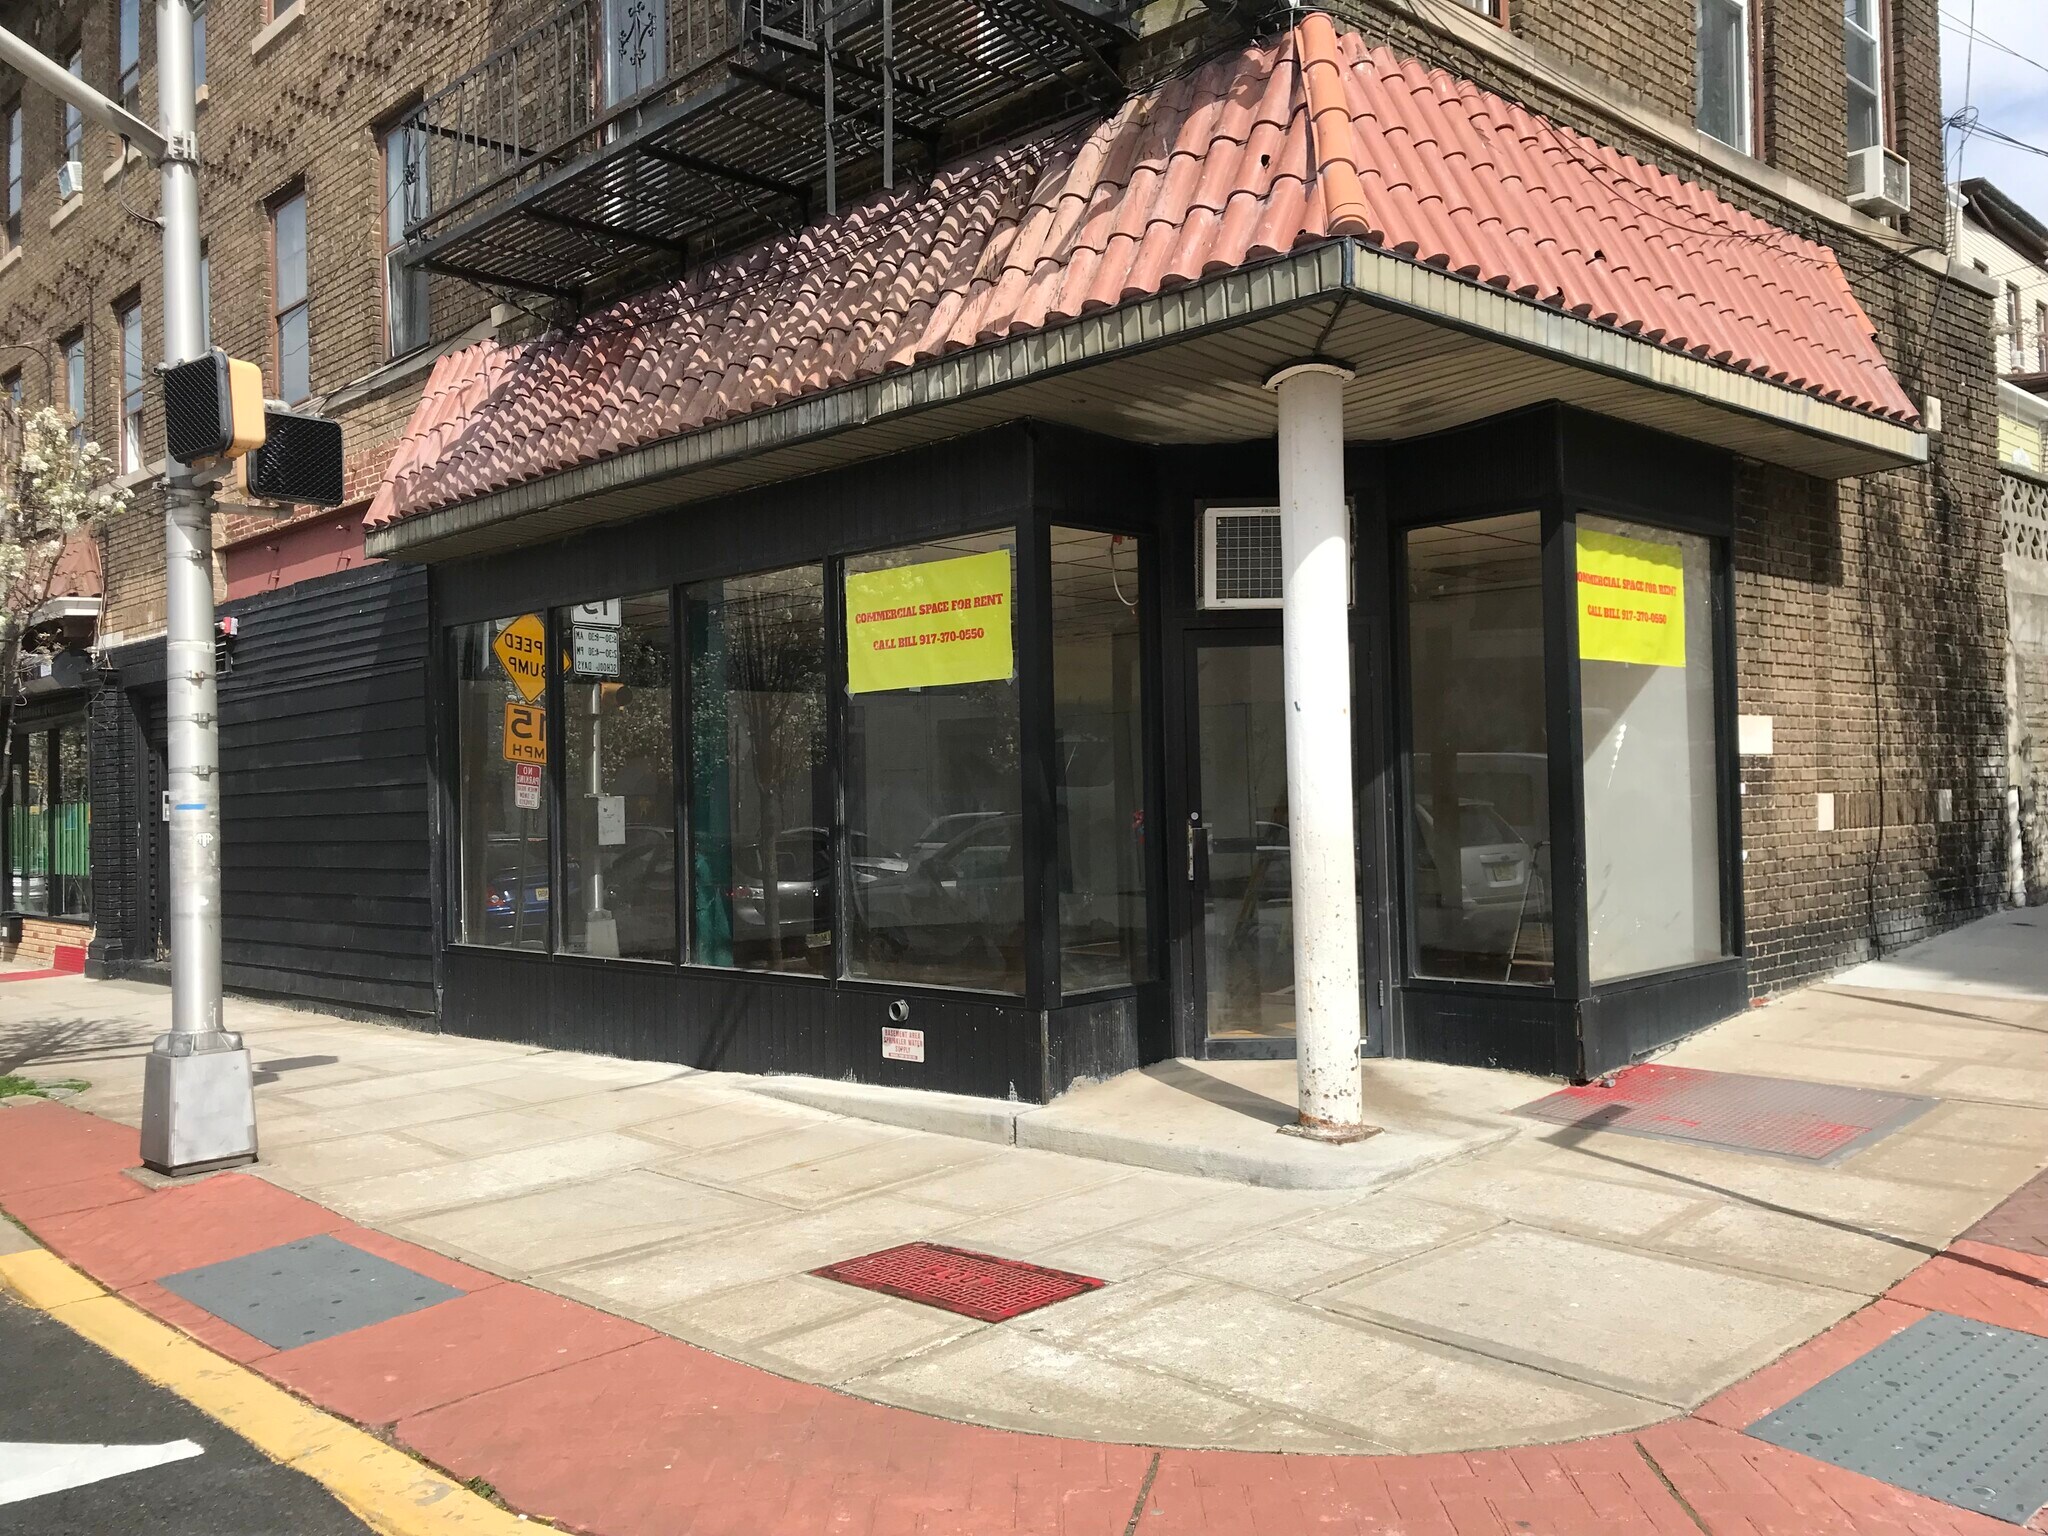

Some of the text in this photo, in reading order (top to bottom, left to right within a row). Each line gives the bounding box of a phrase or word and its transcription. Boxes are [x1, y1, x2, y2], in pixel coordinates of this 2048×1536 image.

[1577, 571, 1677, 597] OMMERCIAL SPACE FOR RENT
[855, 593, 1004, 624] COMMERCIAL SPACE FOR RENT
[1587, 604, 1667, 624] CALL BILL 917-370-0550
[873, 628, 984, 650] CALL BILL 917-370-0550
